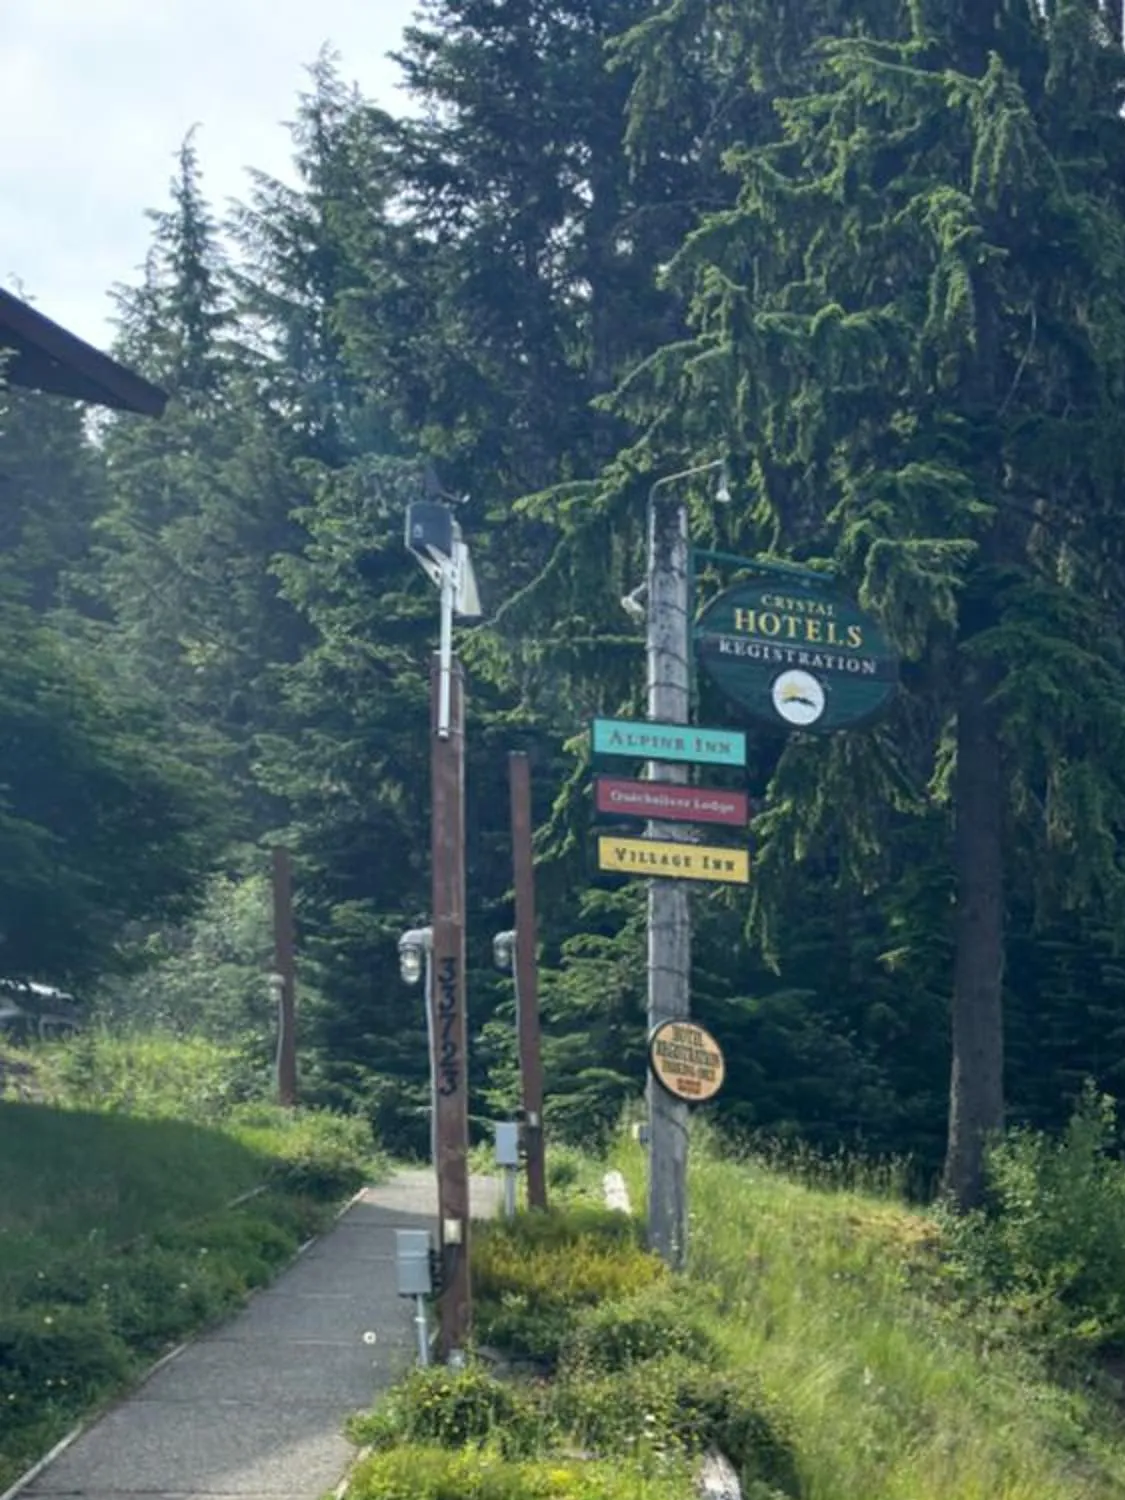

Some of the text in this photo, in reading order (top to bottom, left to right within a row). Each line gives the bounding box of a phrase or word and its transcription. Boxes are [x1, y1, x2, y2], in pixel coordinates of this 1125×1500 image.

[761, 594, 834, 616] CRYSTAL
[734, 608, 863, 648] HOTELS
[719, 638, 877, 674] REGISTRATION
[615, 848, 692, 868] VILLAGE
[438, 956, 459, 1096] 33723
